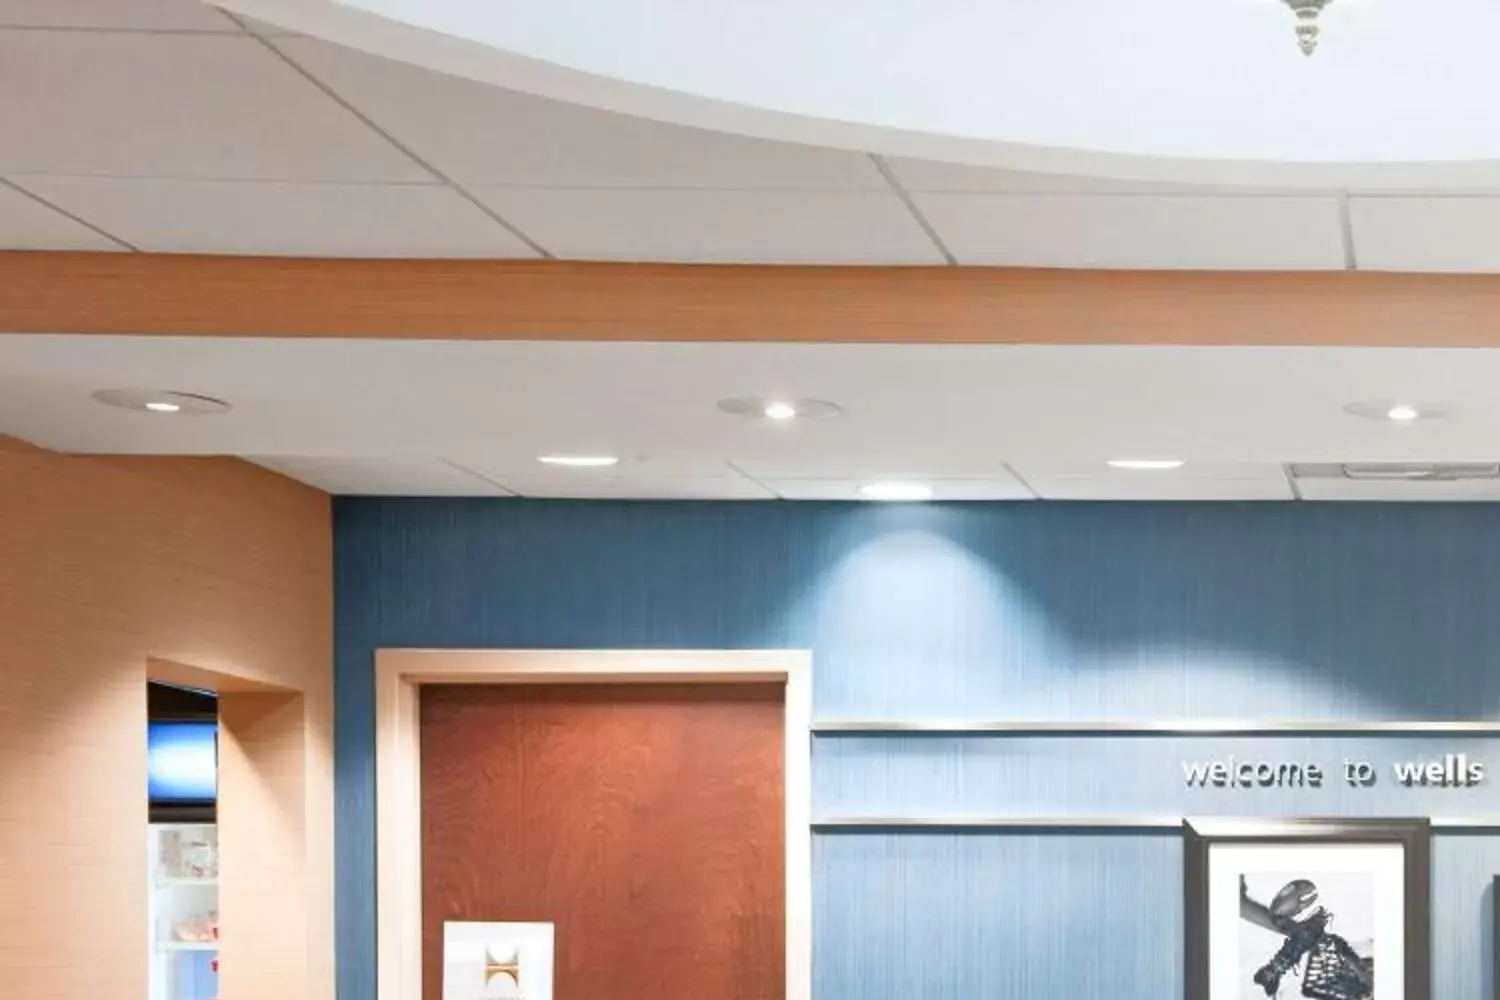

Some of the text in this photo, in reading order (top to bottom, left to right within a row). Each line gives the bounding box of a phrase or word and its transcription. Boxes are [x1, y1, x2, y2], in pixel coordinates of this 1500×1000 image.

[1181, 753, 1486, 787] welcome to wells
